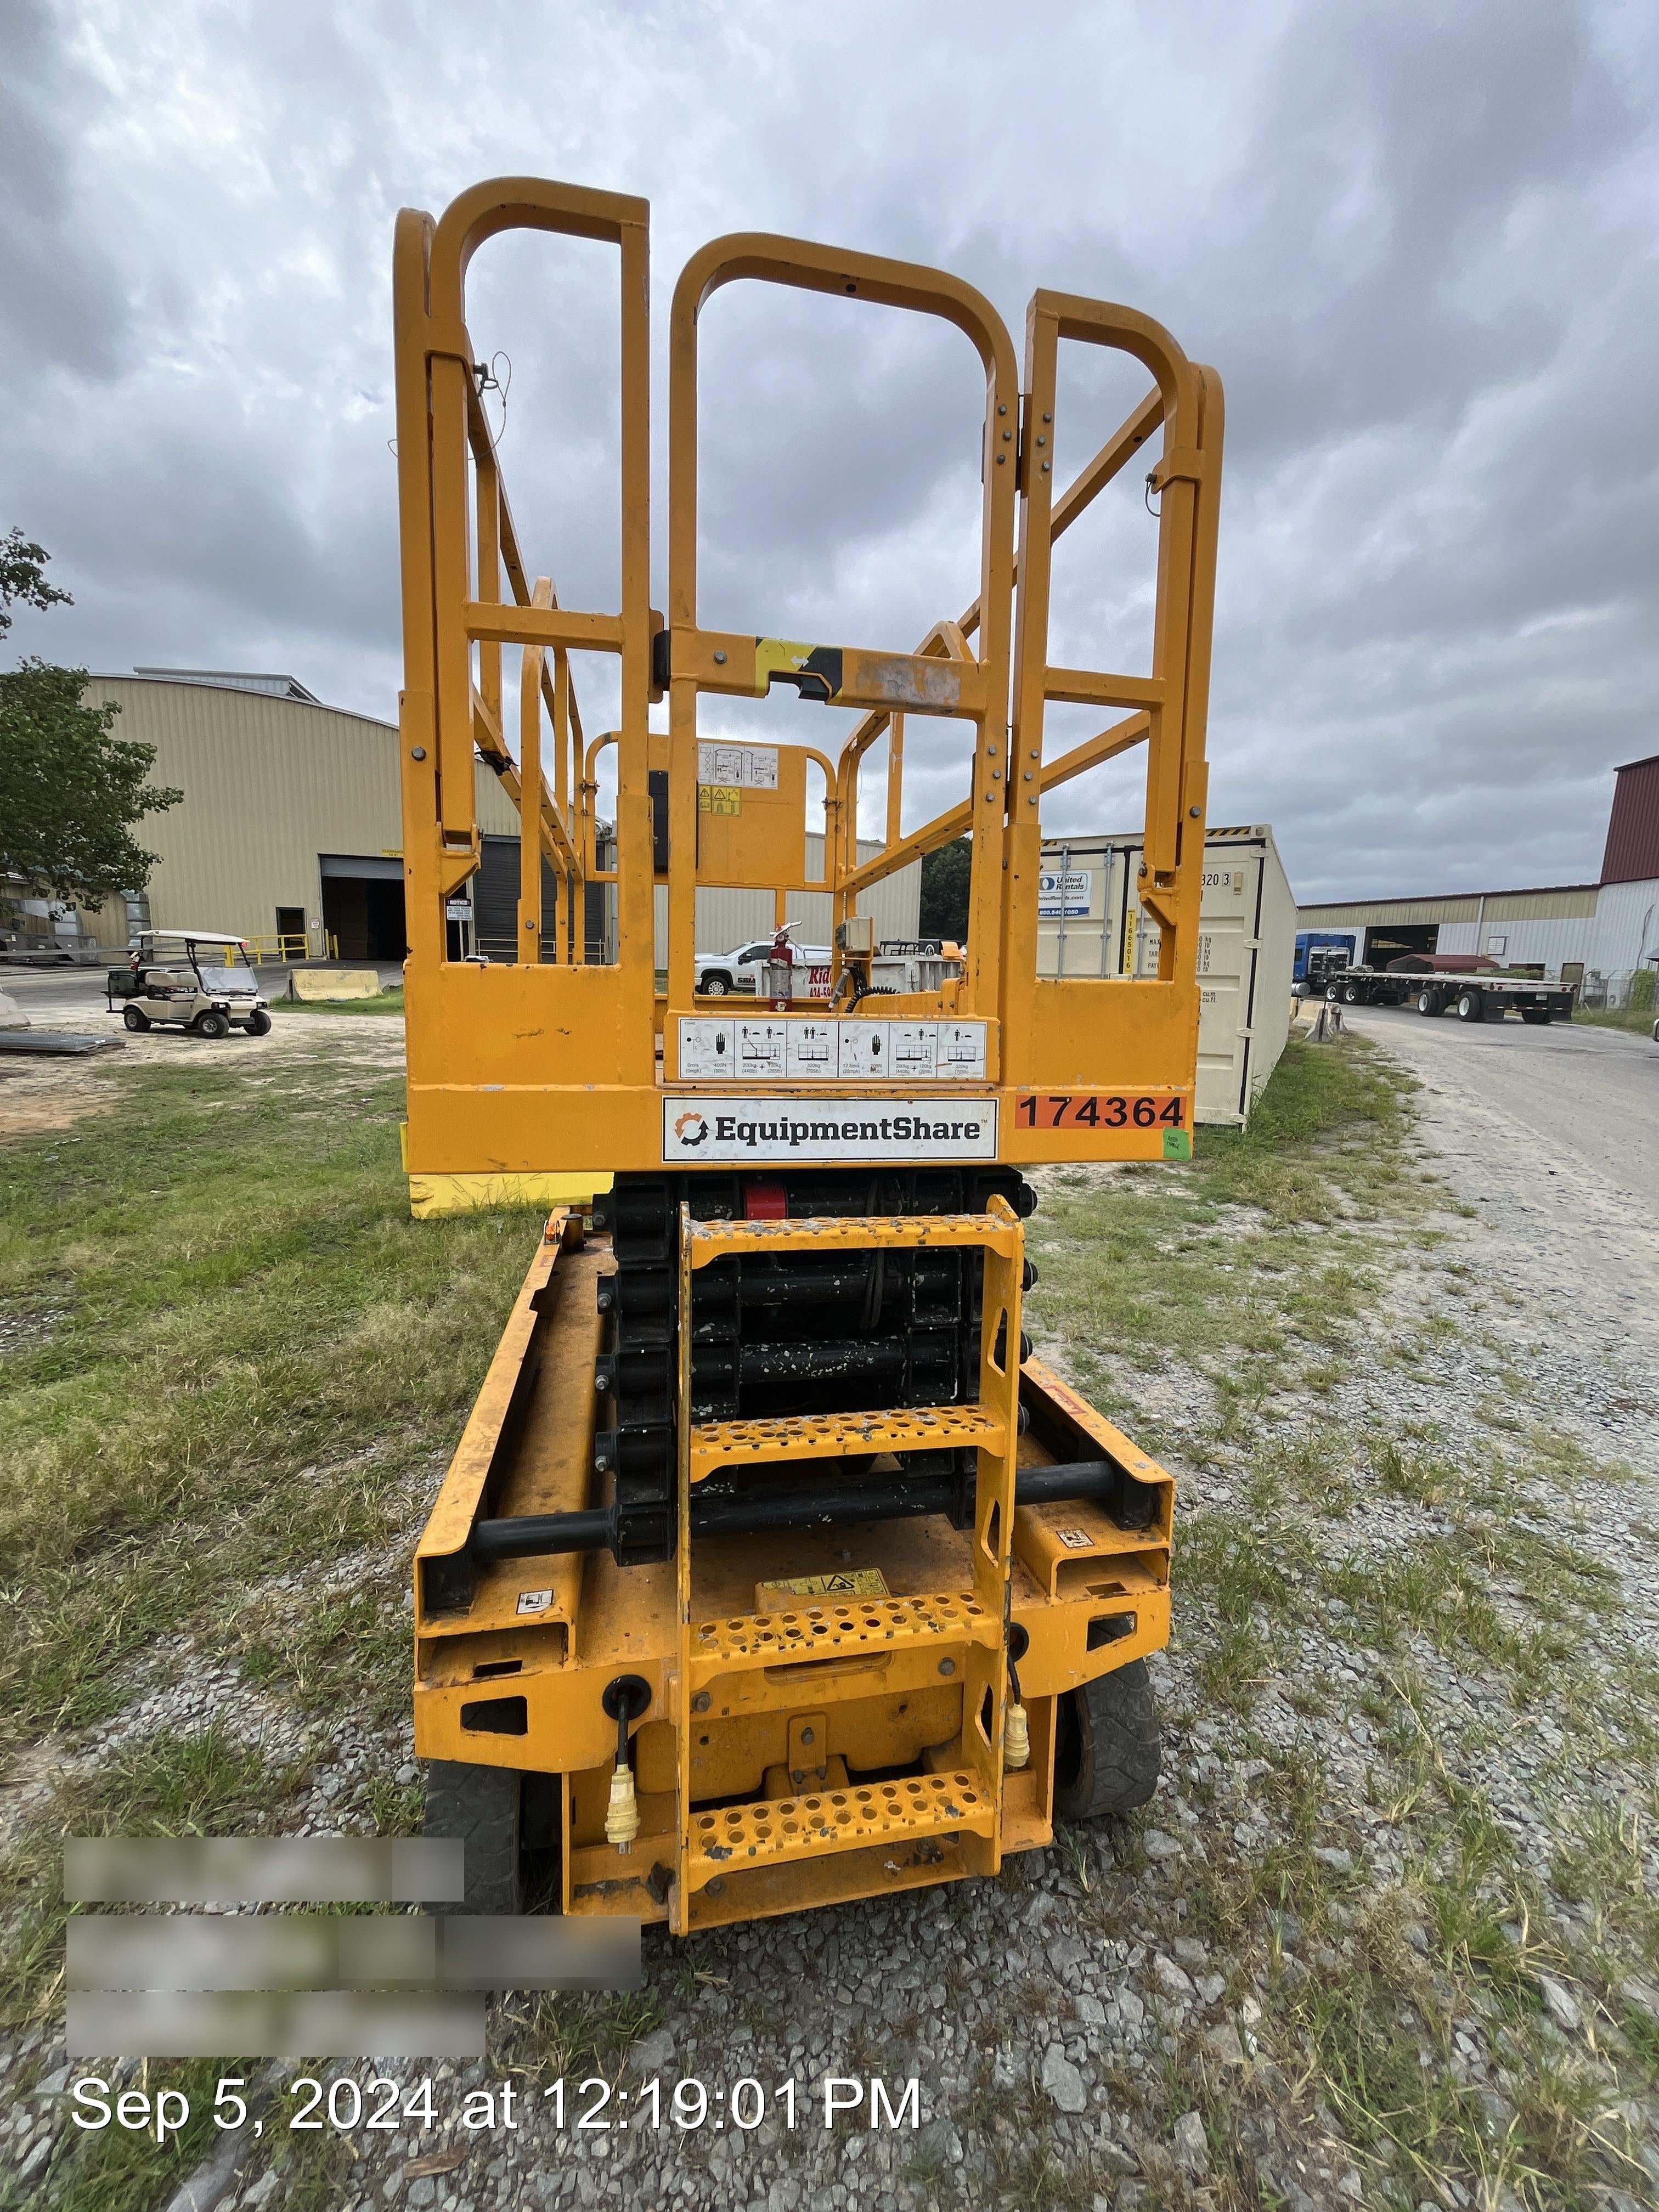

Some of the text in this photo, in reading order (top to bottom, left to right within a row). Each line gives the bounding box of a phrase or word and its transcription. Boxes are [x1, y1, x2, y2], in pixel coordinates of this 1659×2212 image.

[809, 966, 832, 984] Rid
[1020, 1096, 1183, 1126] 174364
[715, 1117, 980, 1146] EquipmentShare
